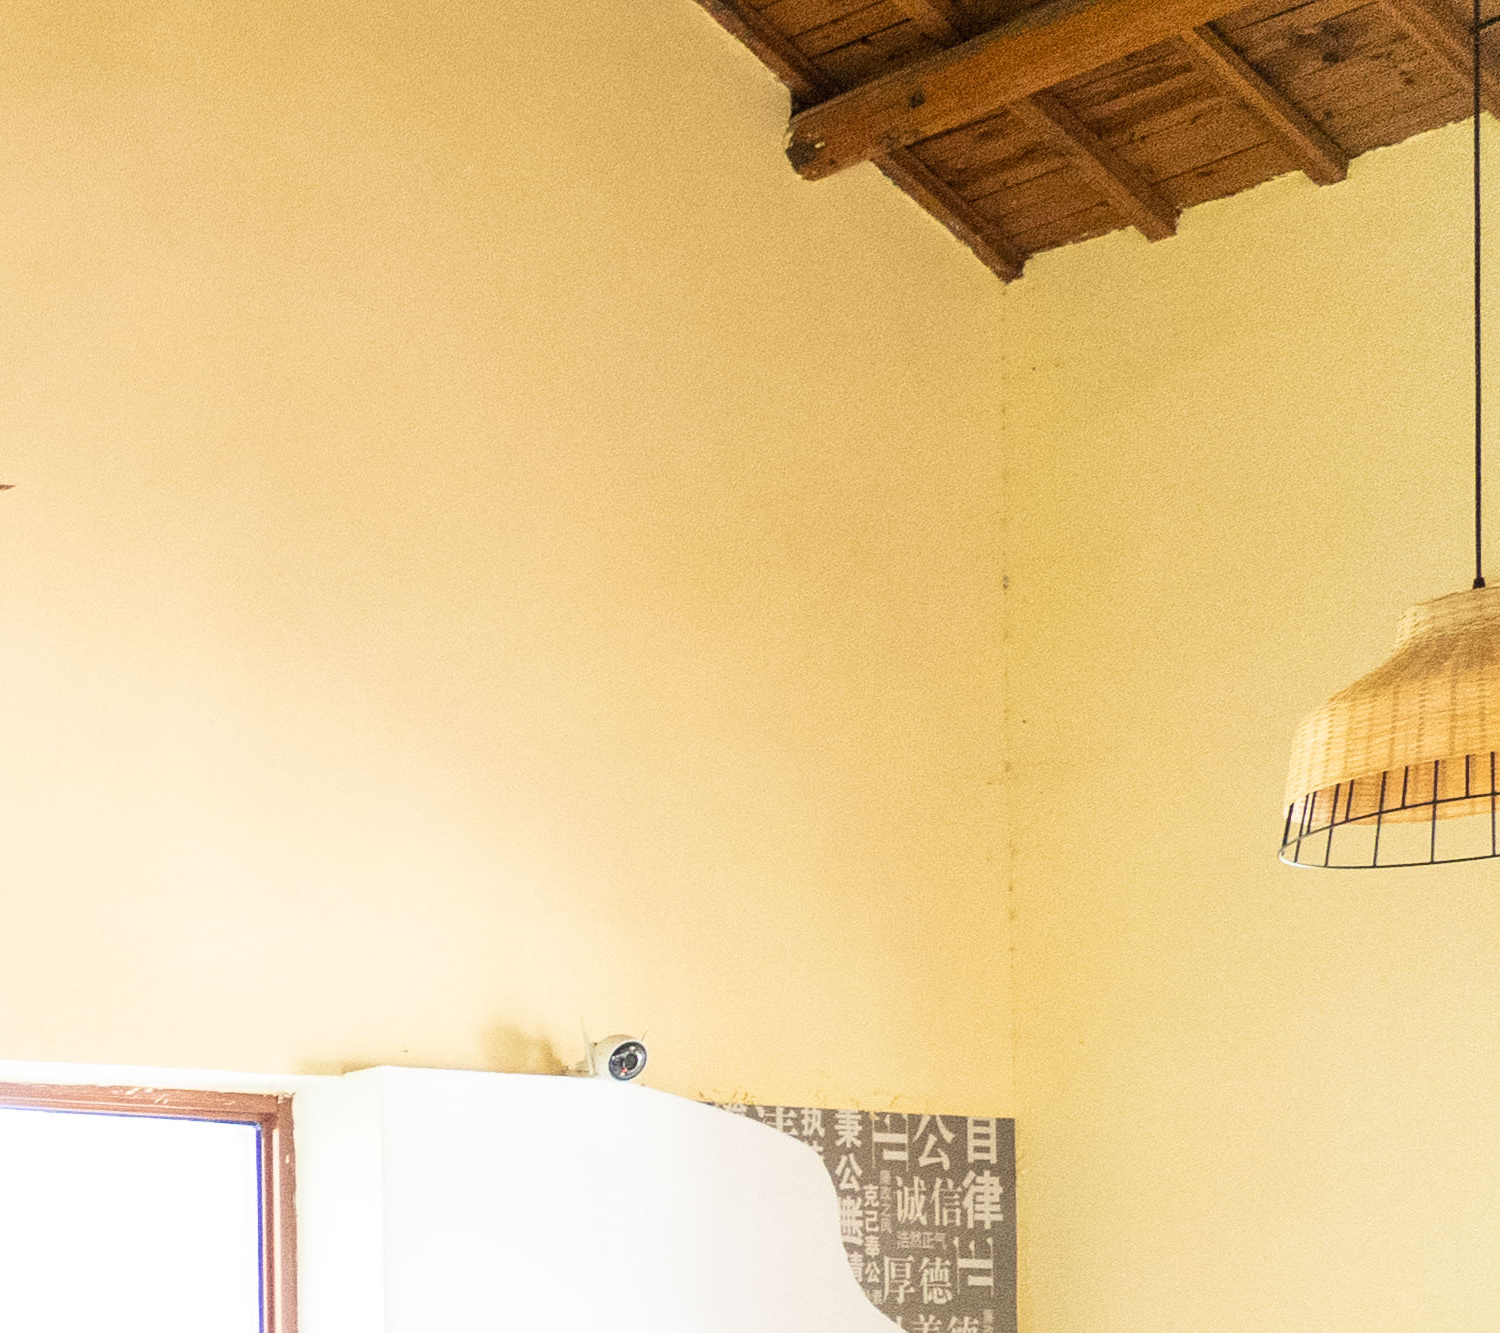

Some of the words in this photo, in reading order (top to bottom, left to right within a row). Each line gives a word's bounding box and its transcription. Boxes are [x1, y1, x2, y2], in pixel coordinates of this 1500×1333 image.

[895, 1175, 963, 1227] 诚信
[863, 1183, 882, 1284] 克己奉公
[882, 1253, 954, 1305] 厚德
